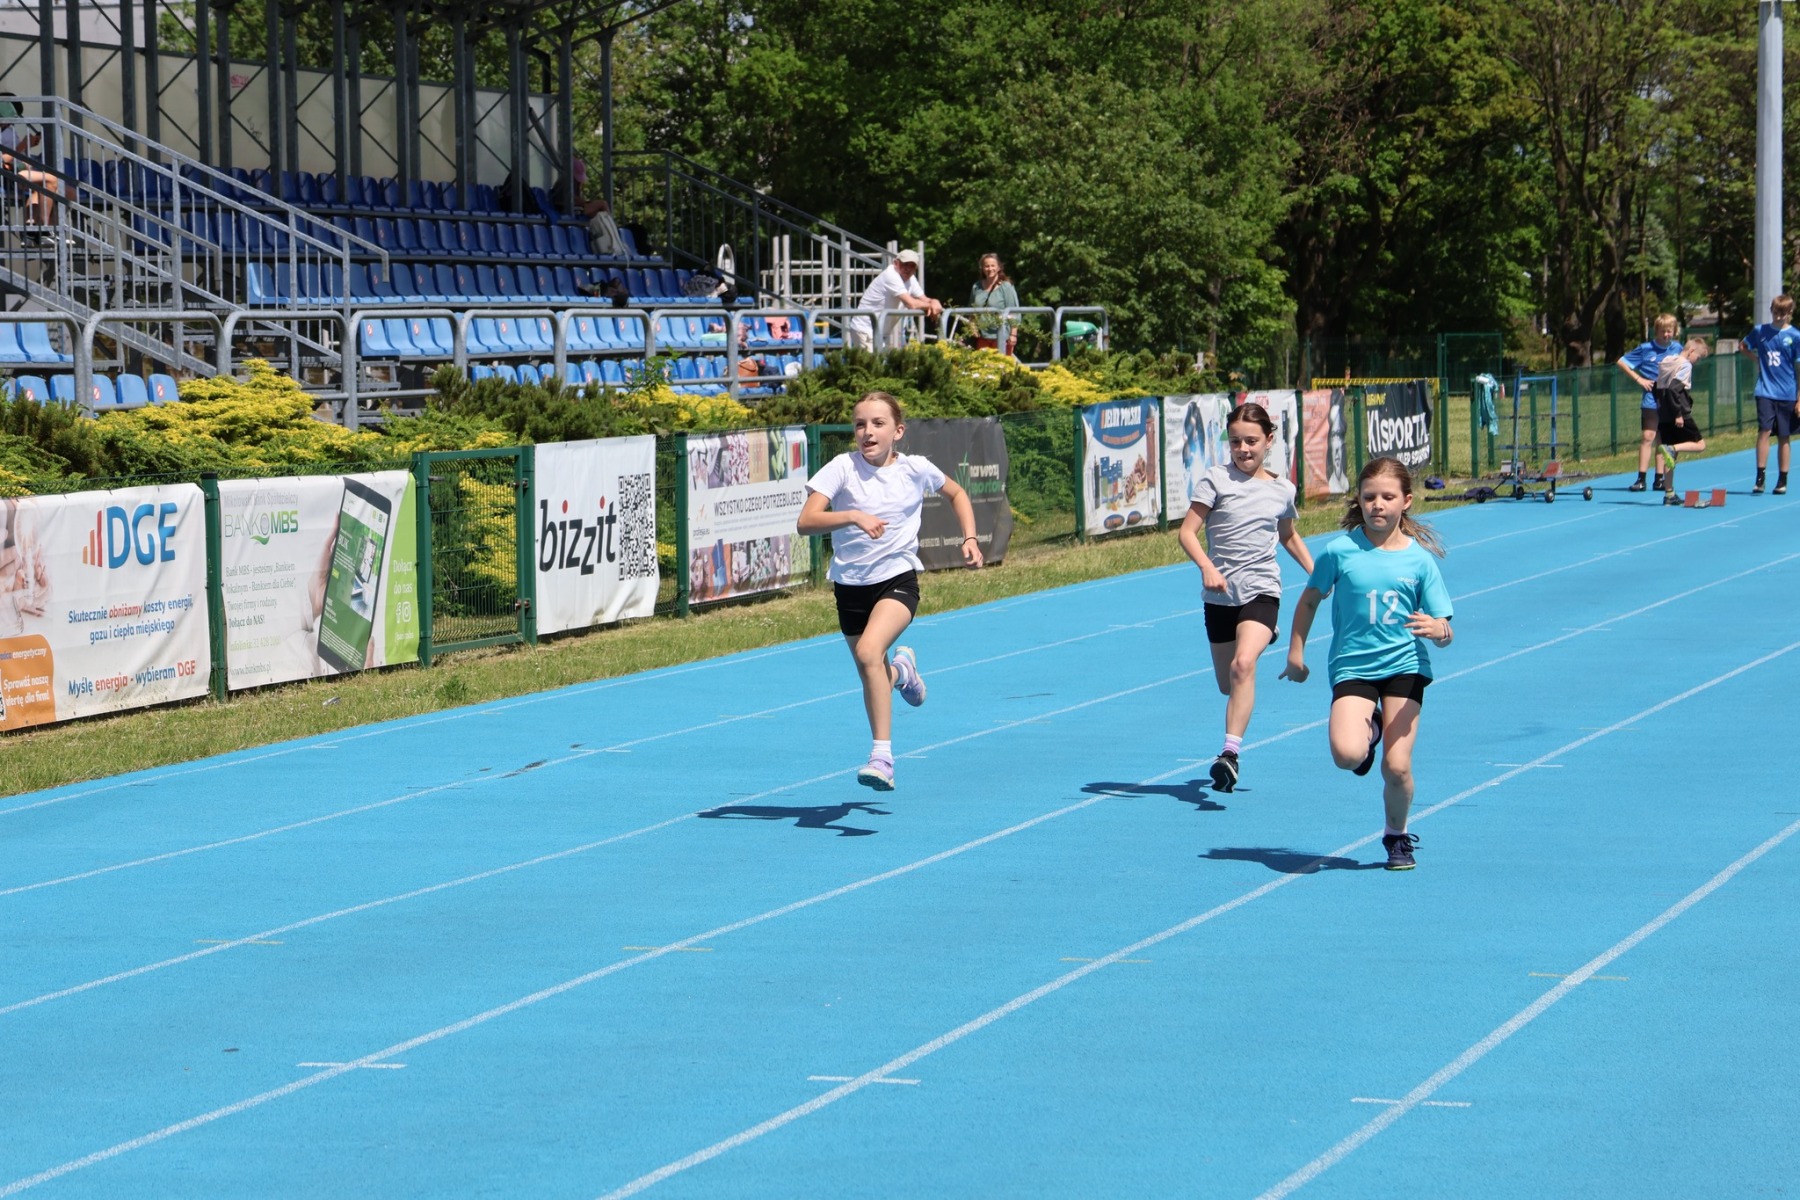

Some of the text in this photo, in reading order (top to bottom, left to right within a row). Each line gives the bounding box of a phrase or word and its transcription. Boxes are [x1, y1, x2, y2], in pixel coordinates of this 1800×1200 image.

[1767, 351, 1781, 367] 15
[714, 490, 803, 516] WSZYSTKO CZEGO POTRZEBUJESZ
[106, 502, 178, 569] DGE
[539, 495, 617, 576] bizzit
[68, 606, 108, 624] Skutecznie
[108, 603, 143, 619] obniżamy
[143, 600, 166, 614] koszty
[1366, 589, 1399, 625] 12
[89, 628, 108, 645] gazu
[113, 622, 135, 641] ciepła
[135, 618, 175, 636] miejskiego
[3, 674, 49, 692] Sprawdź naszą
[68, 676, 93, 698] Myślę
[95, 672, 128, 692] energia
[135, 666, 176, 687] wybieram
[177, 660, 196, 677] DGE
[5, 694, 24, 707] ofertę
[25, 691, 35, 704] dla
